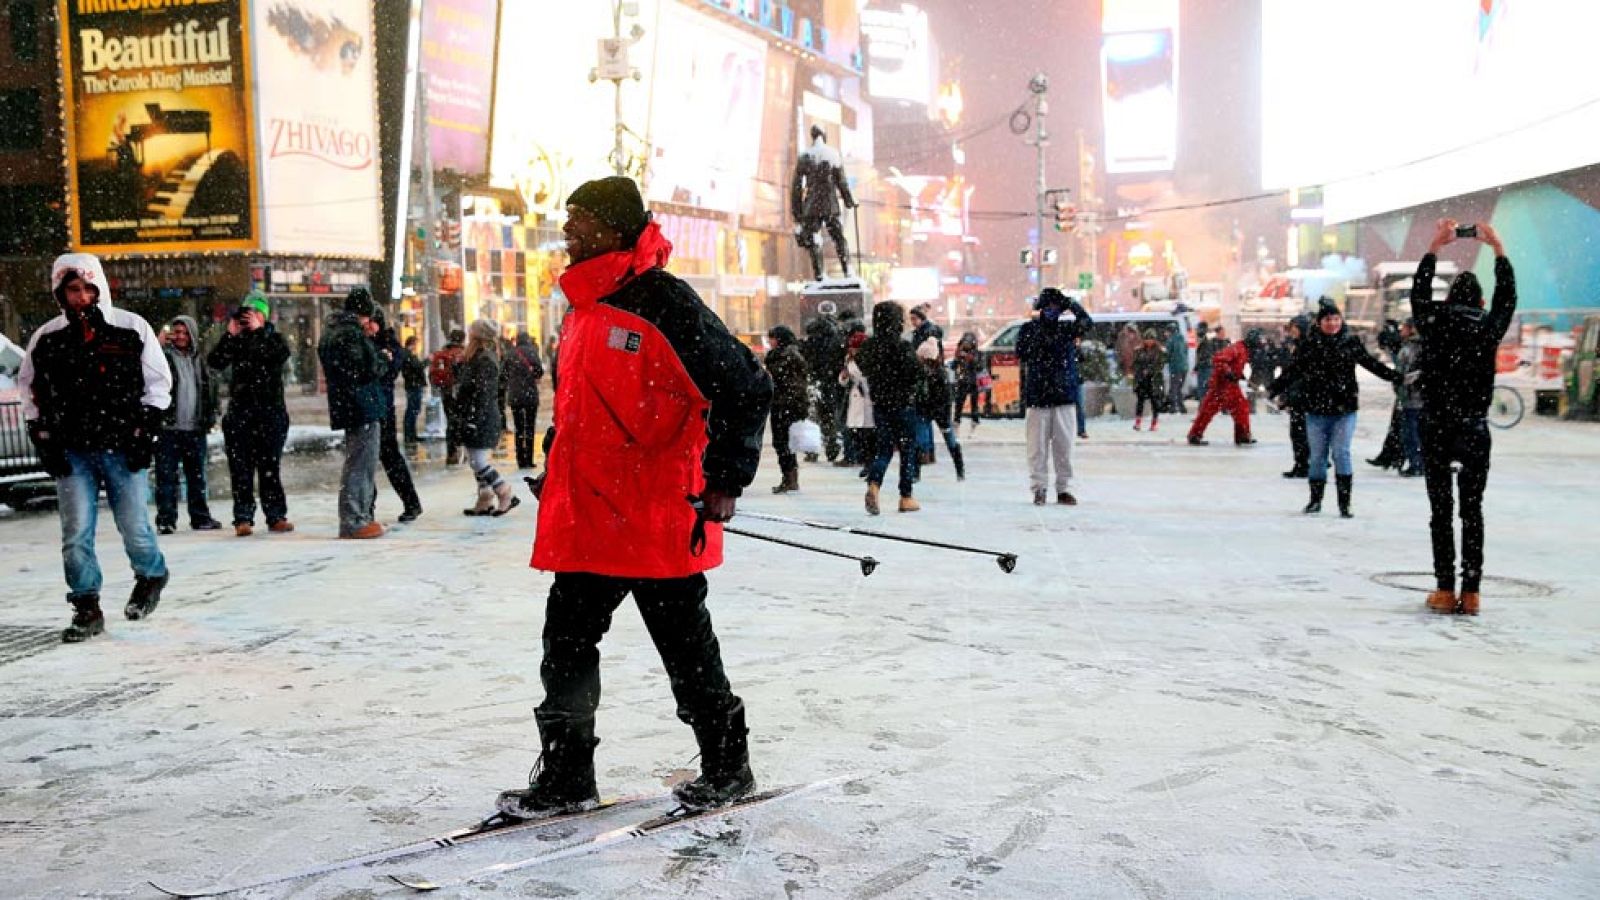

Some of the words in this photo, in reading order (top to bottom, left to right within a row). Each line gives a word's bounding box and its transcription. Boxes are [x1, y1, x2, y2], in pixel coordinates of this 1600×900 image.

[80, 18, 230, 72] Beautiful
[83, 74, 108, 93] The
[108, 72, 150, 92] Carole
[150, 70, 182, 91] King
[183, 66, 232, 86] Musical
[268, 118, 371, 168] ZHIVAGO
